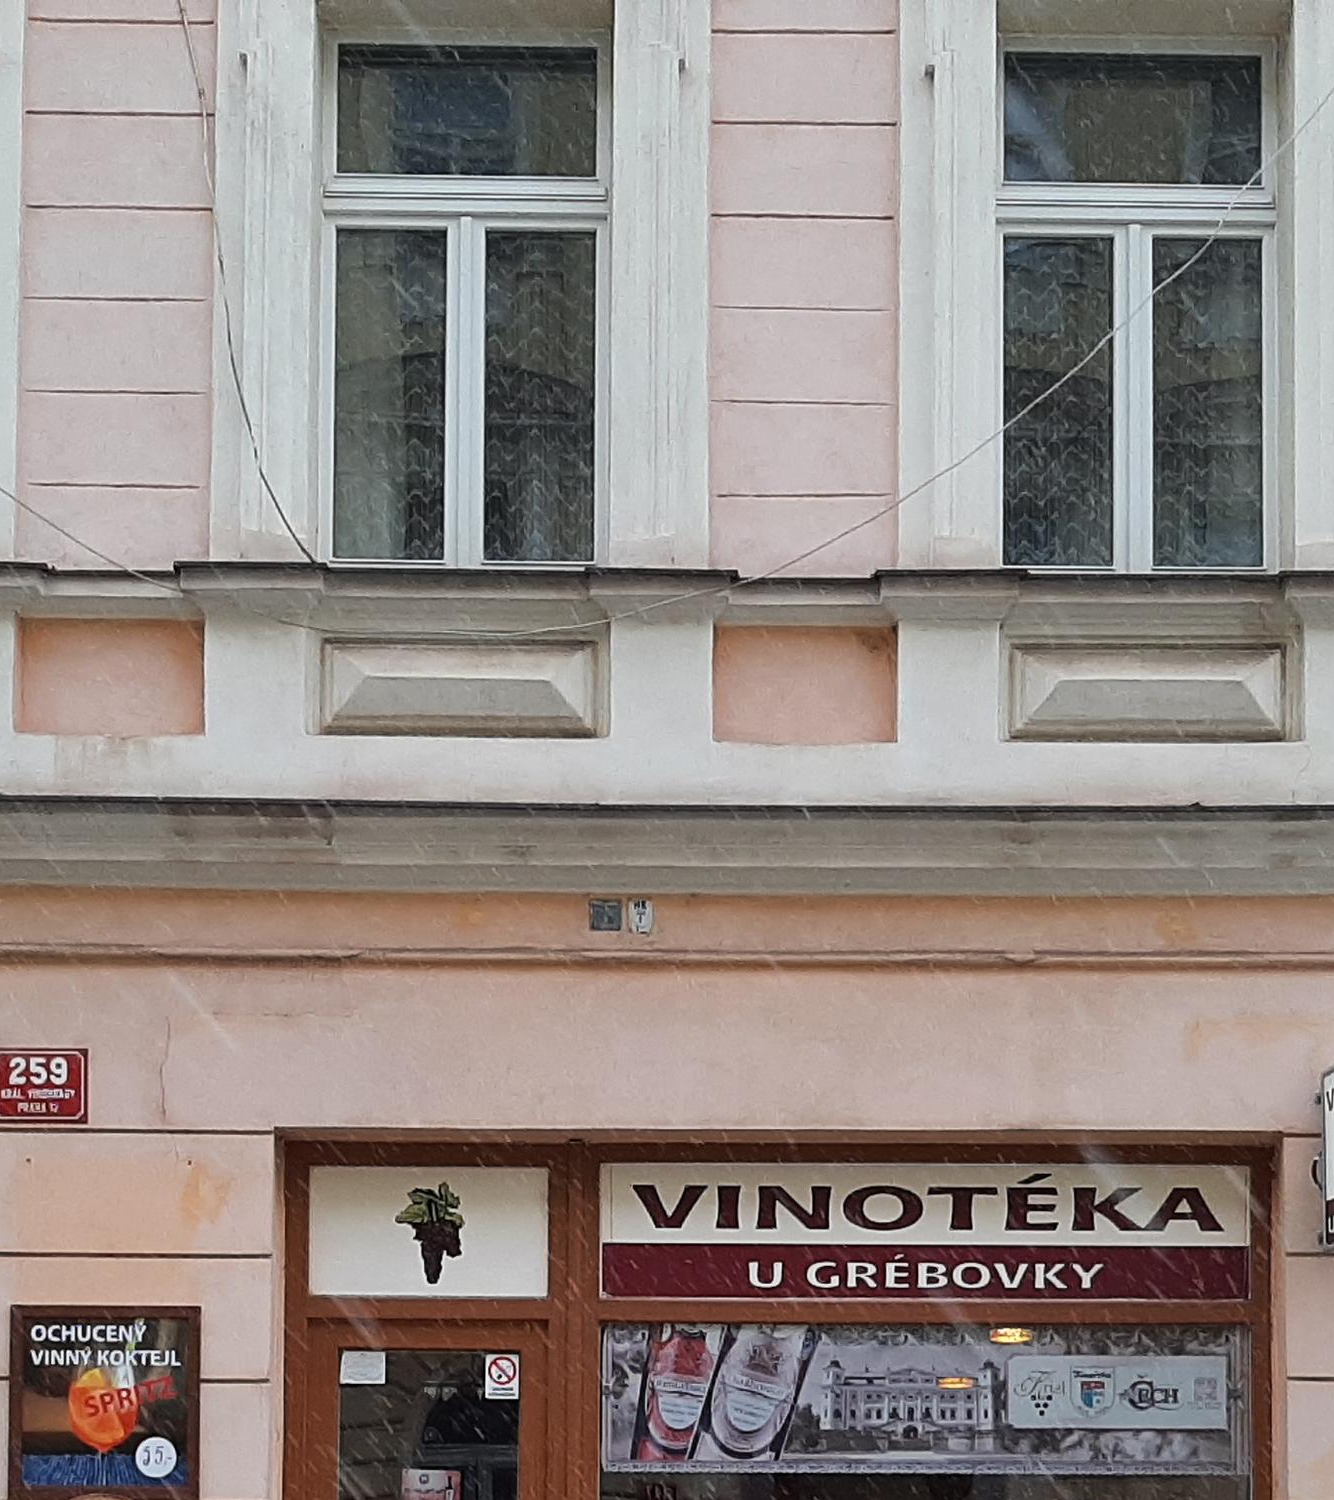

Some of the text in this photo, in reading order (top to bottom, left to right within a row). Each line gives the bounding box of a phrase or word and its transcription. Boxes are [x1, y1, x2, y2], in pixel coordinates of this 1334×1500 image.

[8, 1056, 68, 1085] 259
[631, 1173, 1225, 1233] VINOTÉKA
[747, 1253, 1105, 1291] U GRÉBOVKY
[30, 1346, 182, 1367] VINNÝ KOKTEJL
